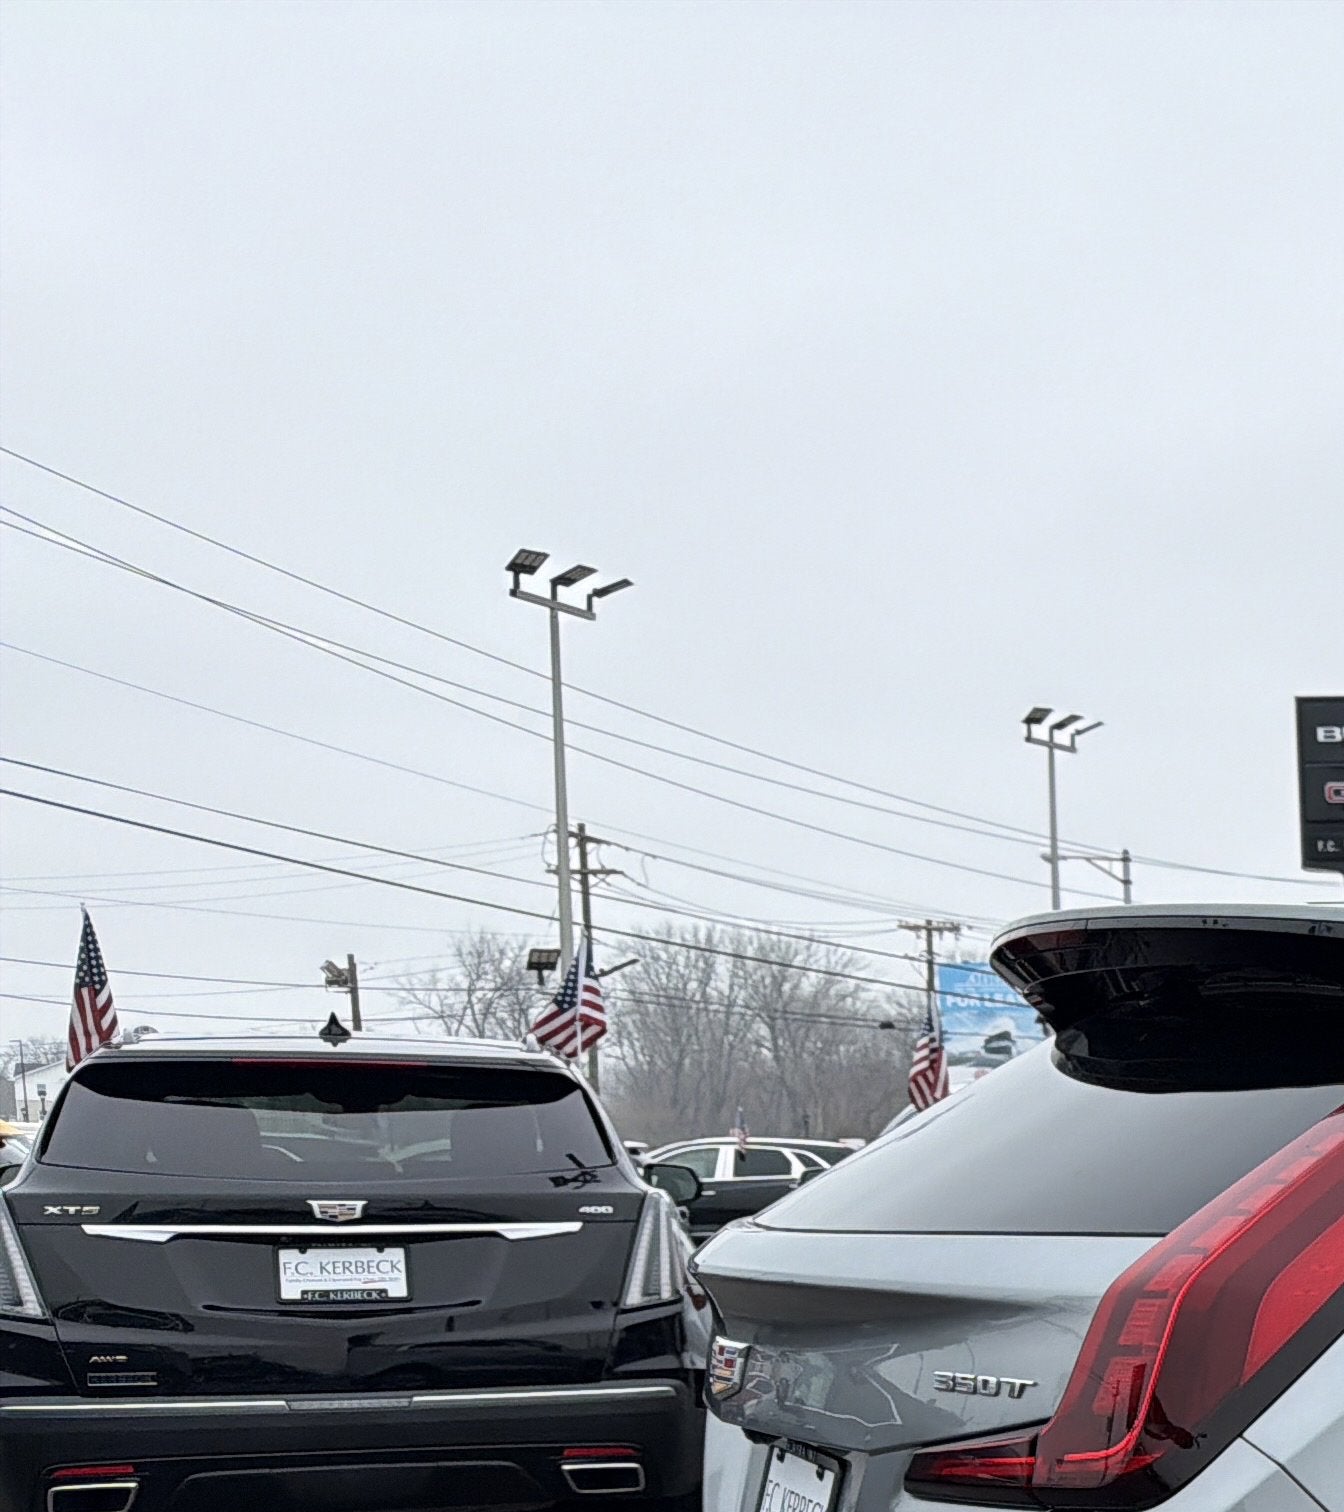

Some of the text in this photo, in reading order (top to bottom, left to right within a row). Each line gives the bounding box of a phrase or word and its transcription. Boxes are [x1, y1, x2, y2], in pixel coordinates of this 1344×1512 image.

[43, 1205, 101, 1215] XT5
[283, 1259, 403, 1276] F.C. KERBECK
[330, 1289, 381, 1300] KERBECK
[933, 1370, 1035, 1399] 350T
